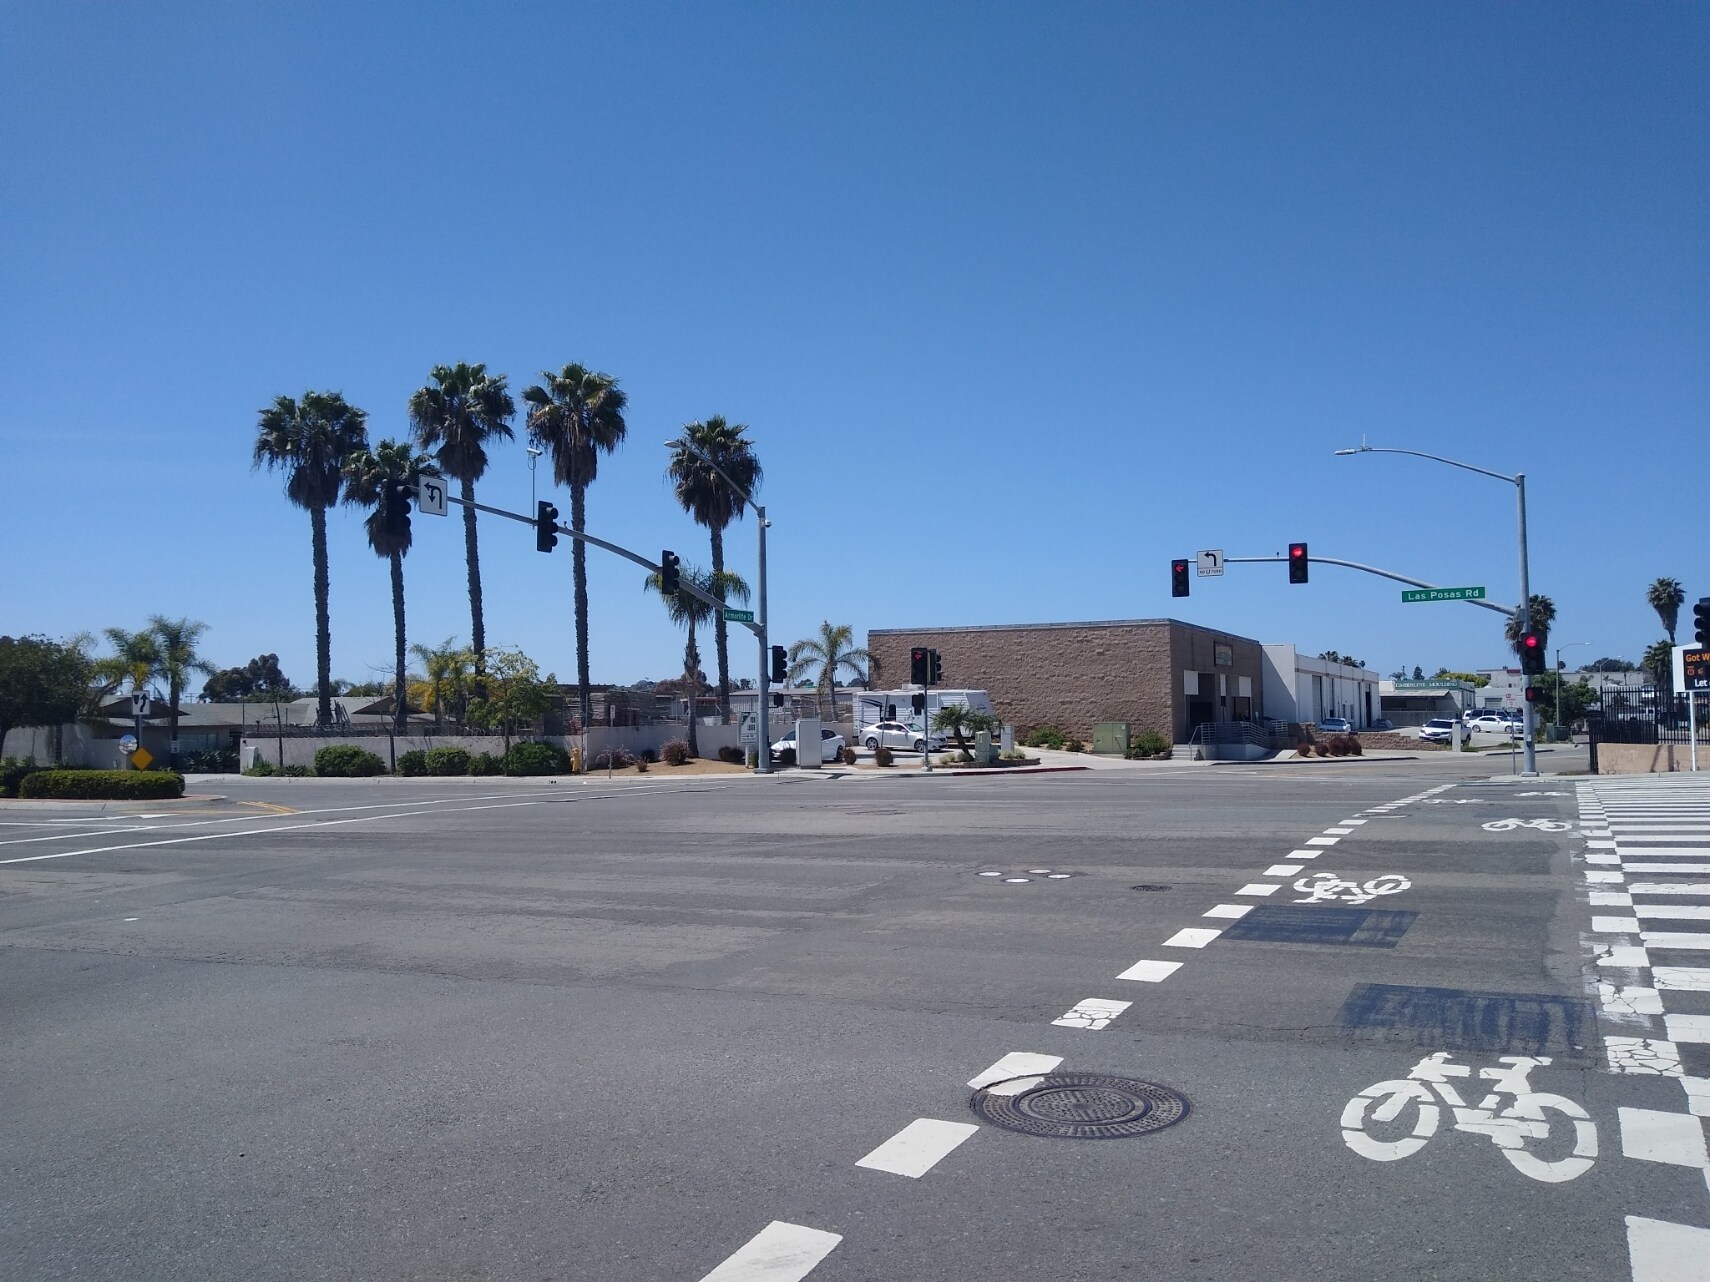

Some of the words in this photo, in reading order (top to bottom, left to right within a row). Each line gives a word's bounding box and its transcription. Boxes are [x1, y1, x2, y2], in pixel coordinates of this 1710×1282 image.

[1430, 590, 1461, 600] Posas
[1466, 589, 1478, 598] Rd
[748, 613, 753, 621] Dr
[1686, 654, 1700, 662] Got
[1694, 678, 1708, 687] Let
